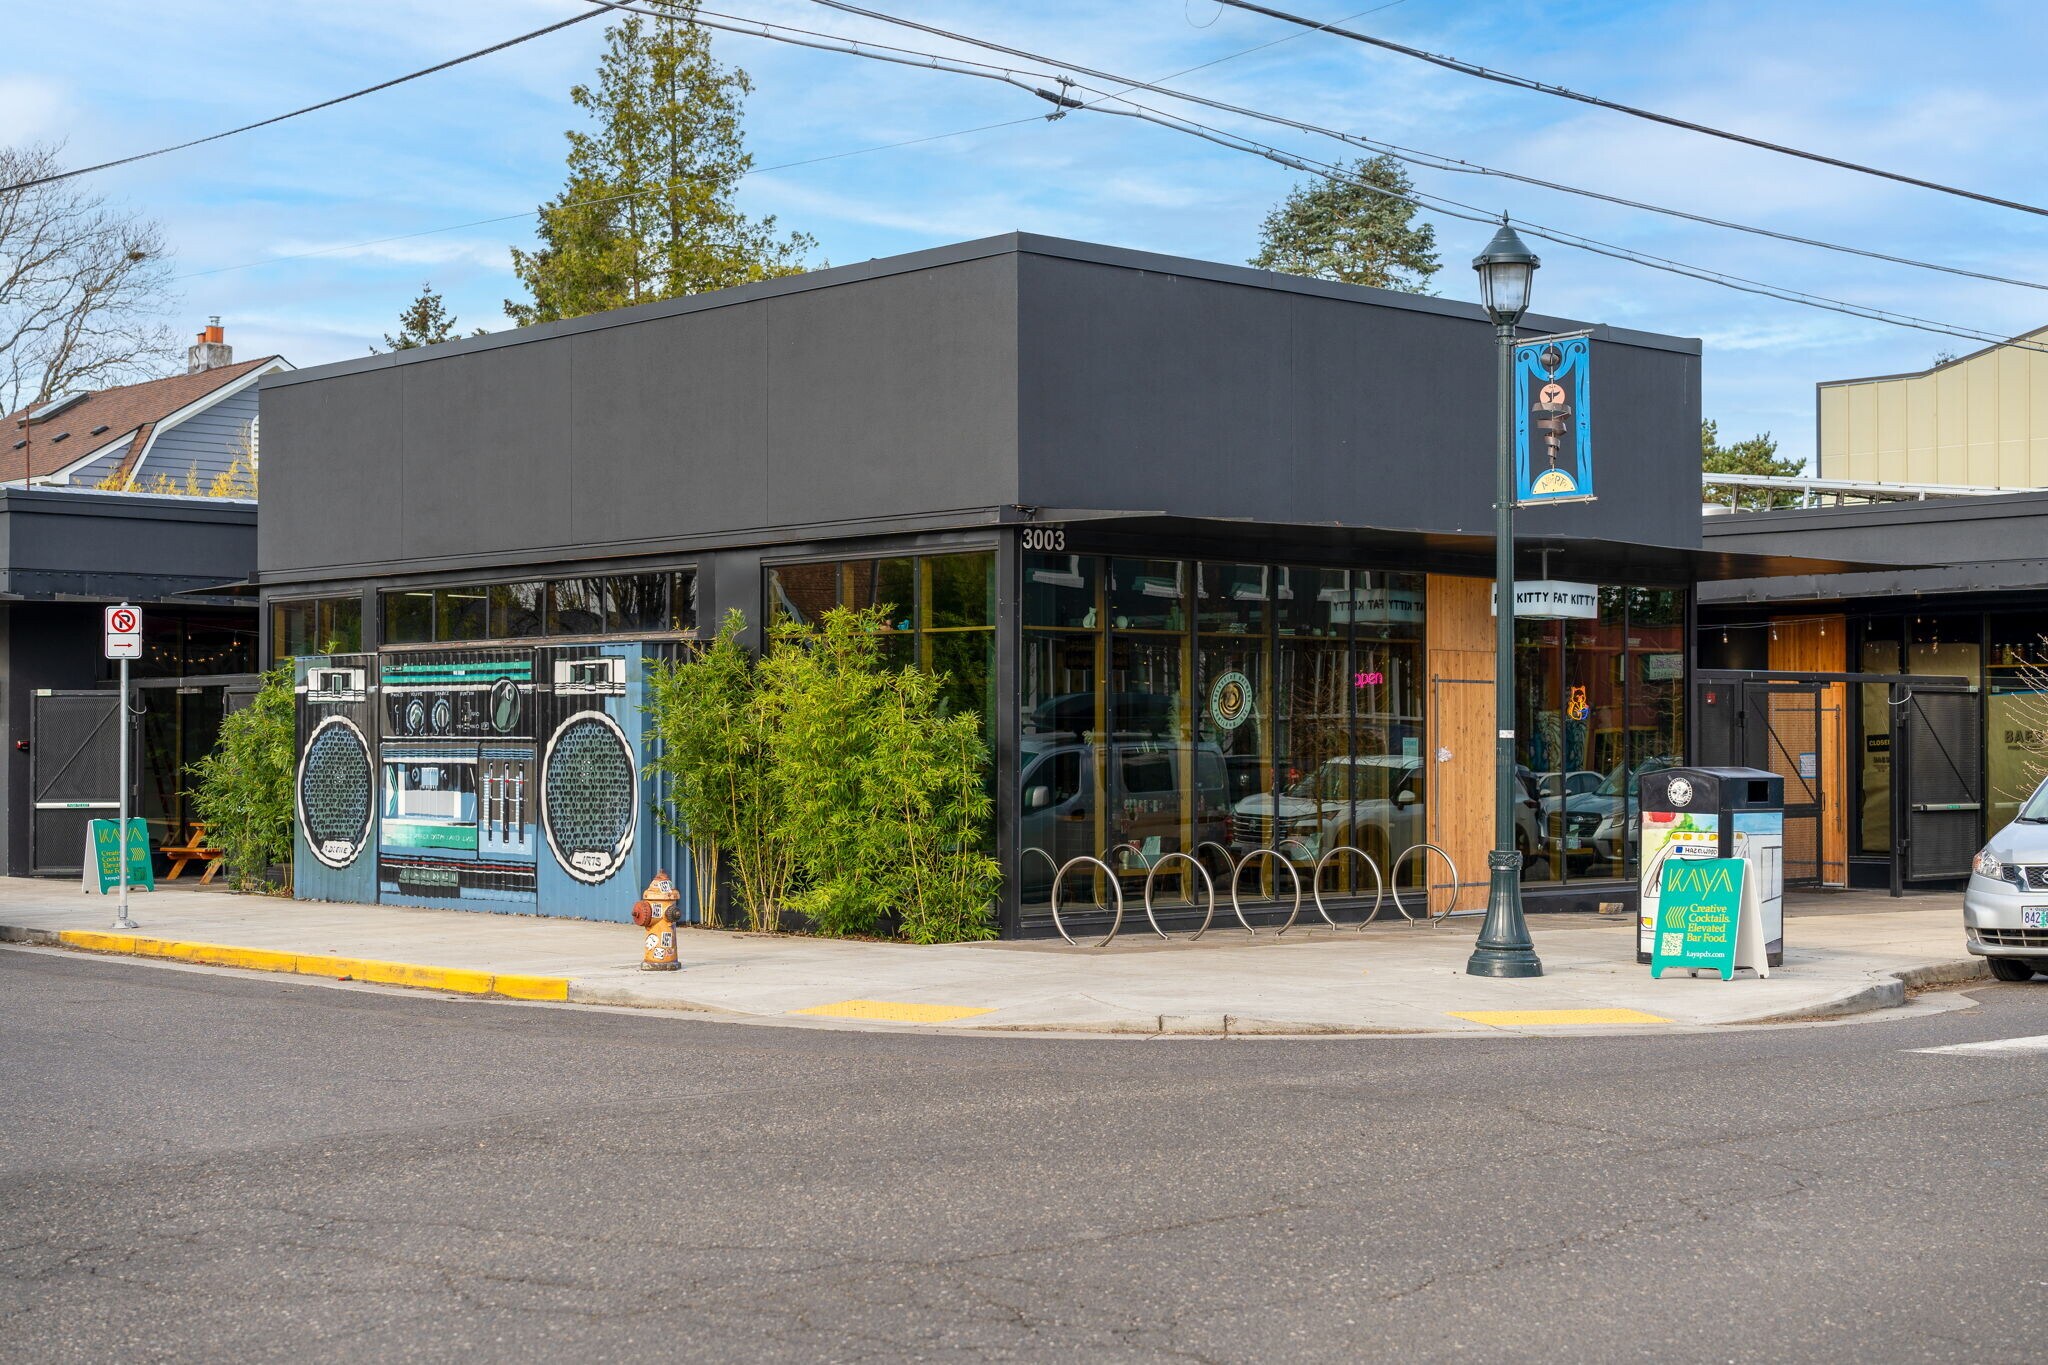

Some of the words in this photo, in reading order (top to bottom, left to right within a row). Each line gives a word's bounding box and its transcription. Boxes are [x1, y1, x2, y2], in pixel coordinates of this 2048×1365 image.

[1022, 528, 1065, 551] 3003
[1516, 592, 1549, 604] KITTY
[1553, 592, 1568, 604] FAT
[1571, 594, 1596, 606] KITTY
[1869, 739, 1890, 747] CLOSE
[1668, 868, 1733, 901] KAYA
[1690, 903, 1727, 913] Creative
[2024, 911, 2041, 924] 842
[1688, 922, 1726, 932] Elevated
[1686, 932, 1702, 942] Bar
